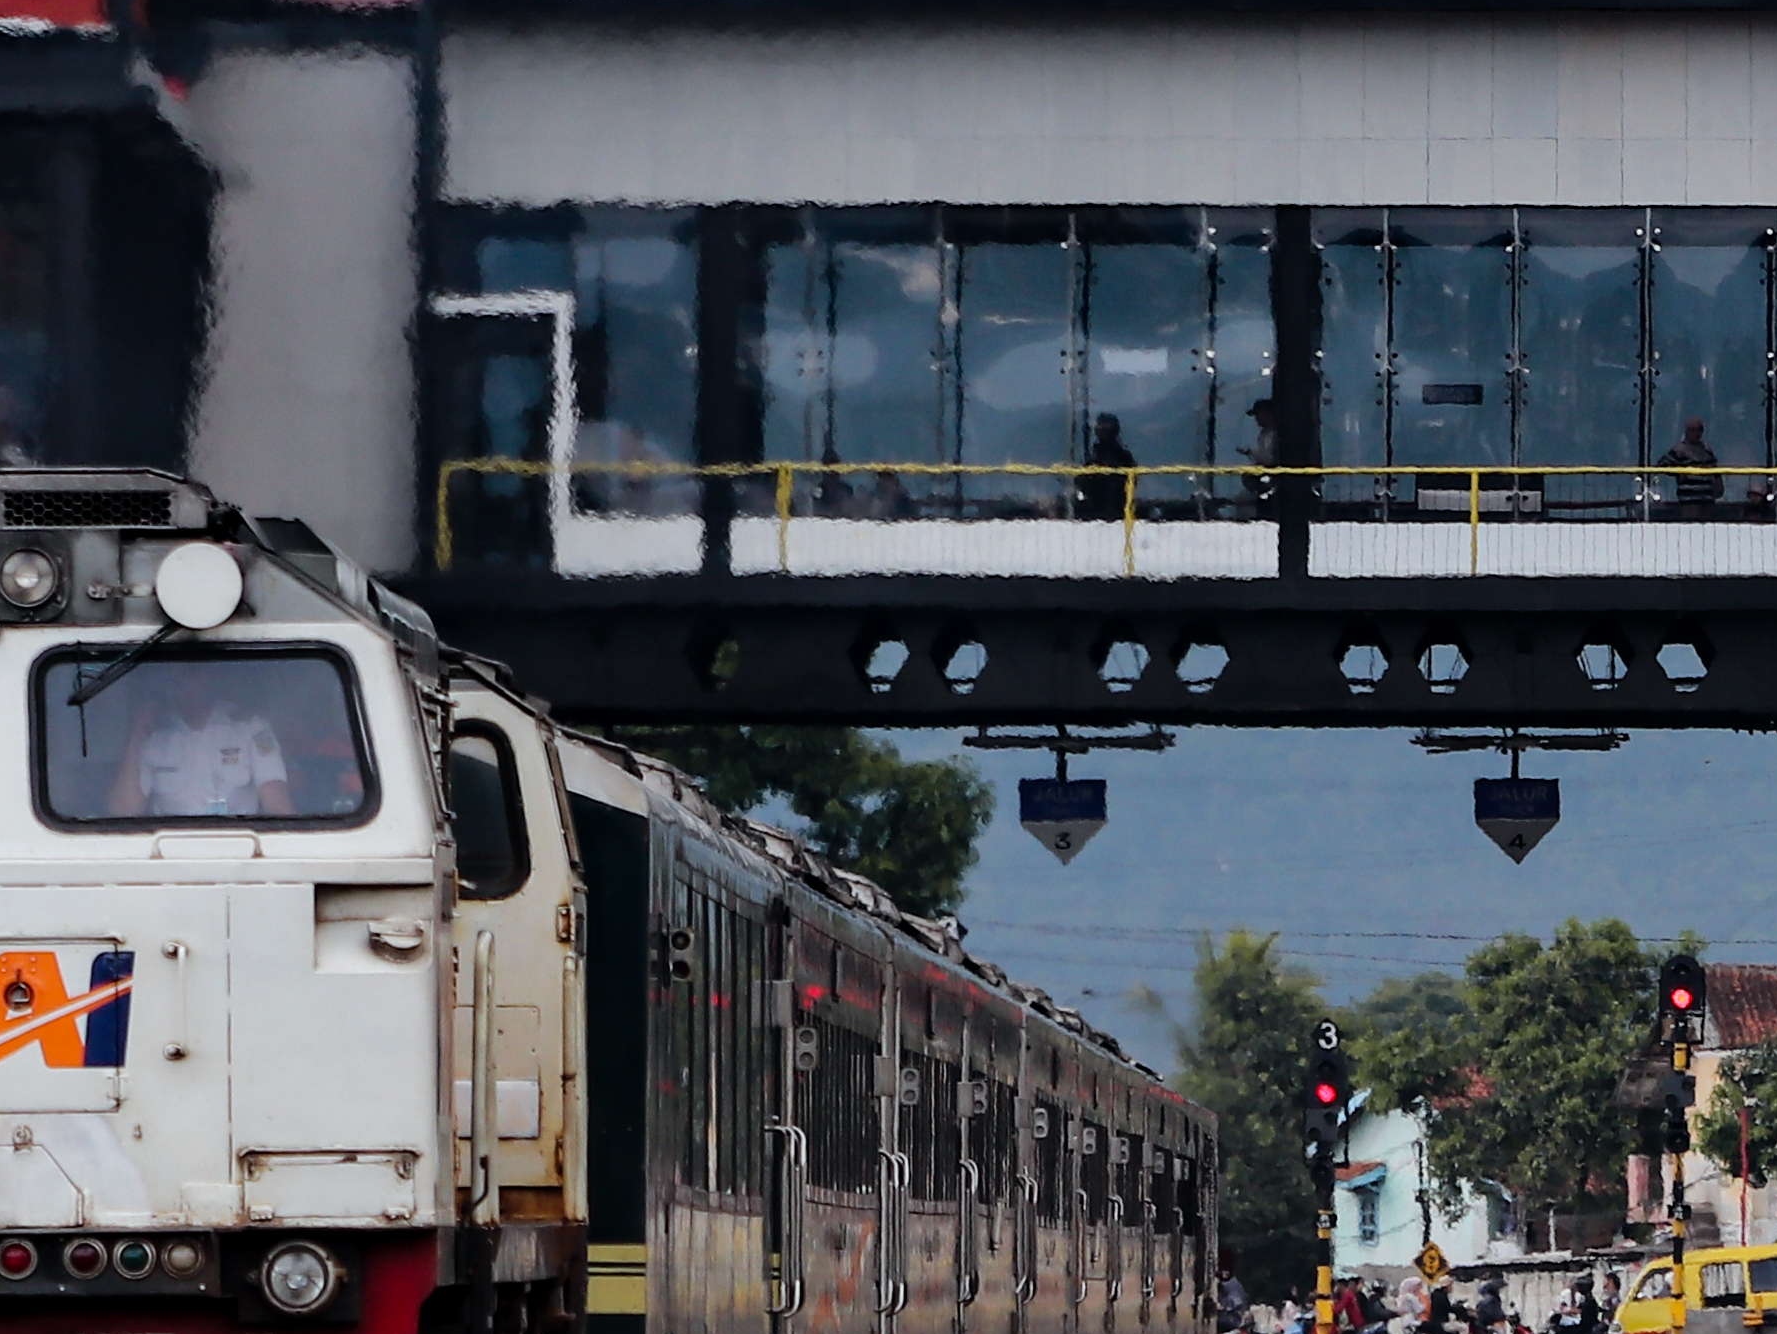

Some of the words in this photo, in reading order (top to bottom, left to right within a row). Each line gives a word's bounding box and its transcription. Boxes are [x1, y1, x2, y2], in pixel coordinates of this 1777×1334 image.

[1054, 832, 1072, 850] 3
[1508, 833, 1527, 850] 4
[1318, 1021, 1339, 1050] 3
